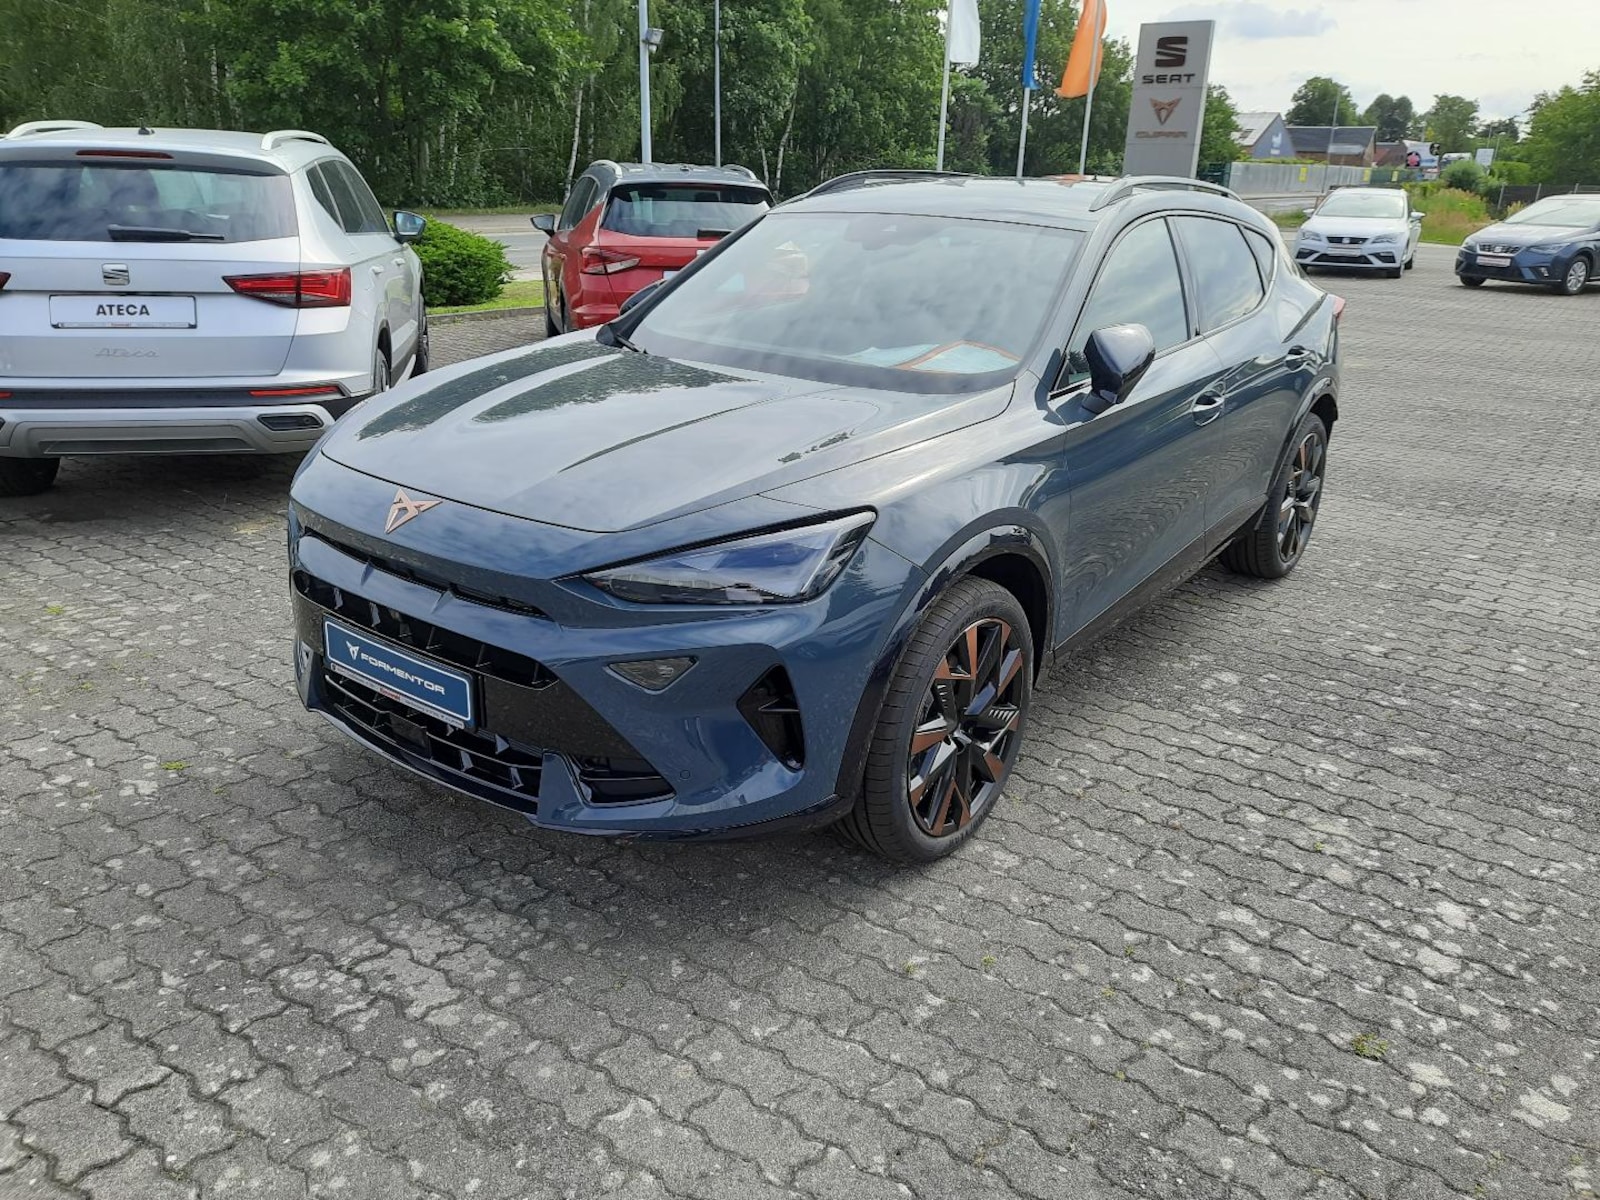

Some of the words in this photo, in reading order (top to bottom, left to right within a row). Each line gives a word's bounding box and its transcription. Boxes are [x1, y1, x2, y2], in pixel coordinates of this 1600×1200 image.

[1142, 73, 1196, 84] SEAT
[96, 304, 150, 316] ATECA
[361, 652, 446, 695] FORMENTOR
